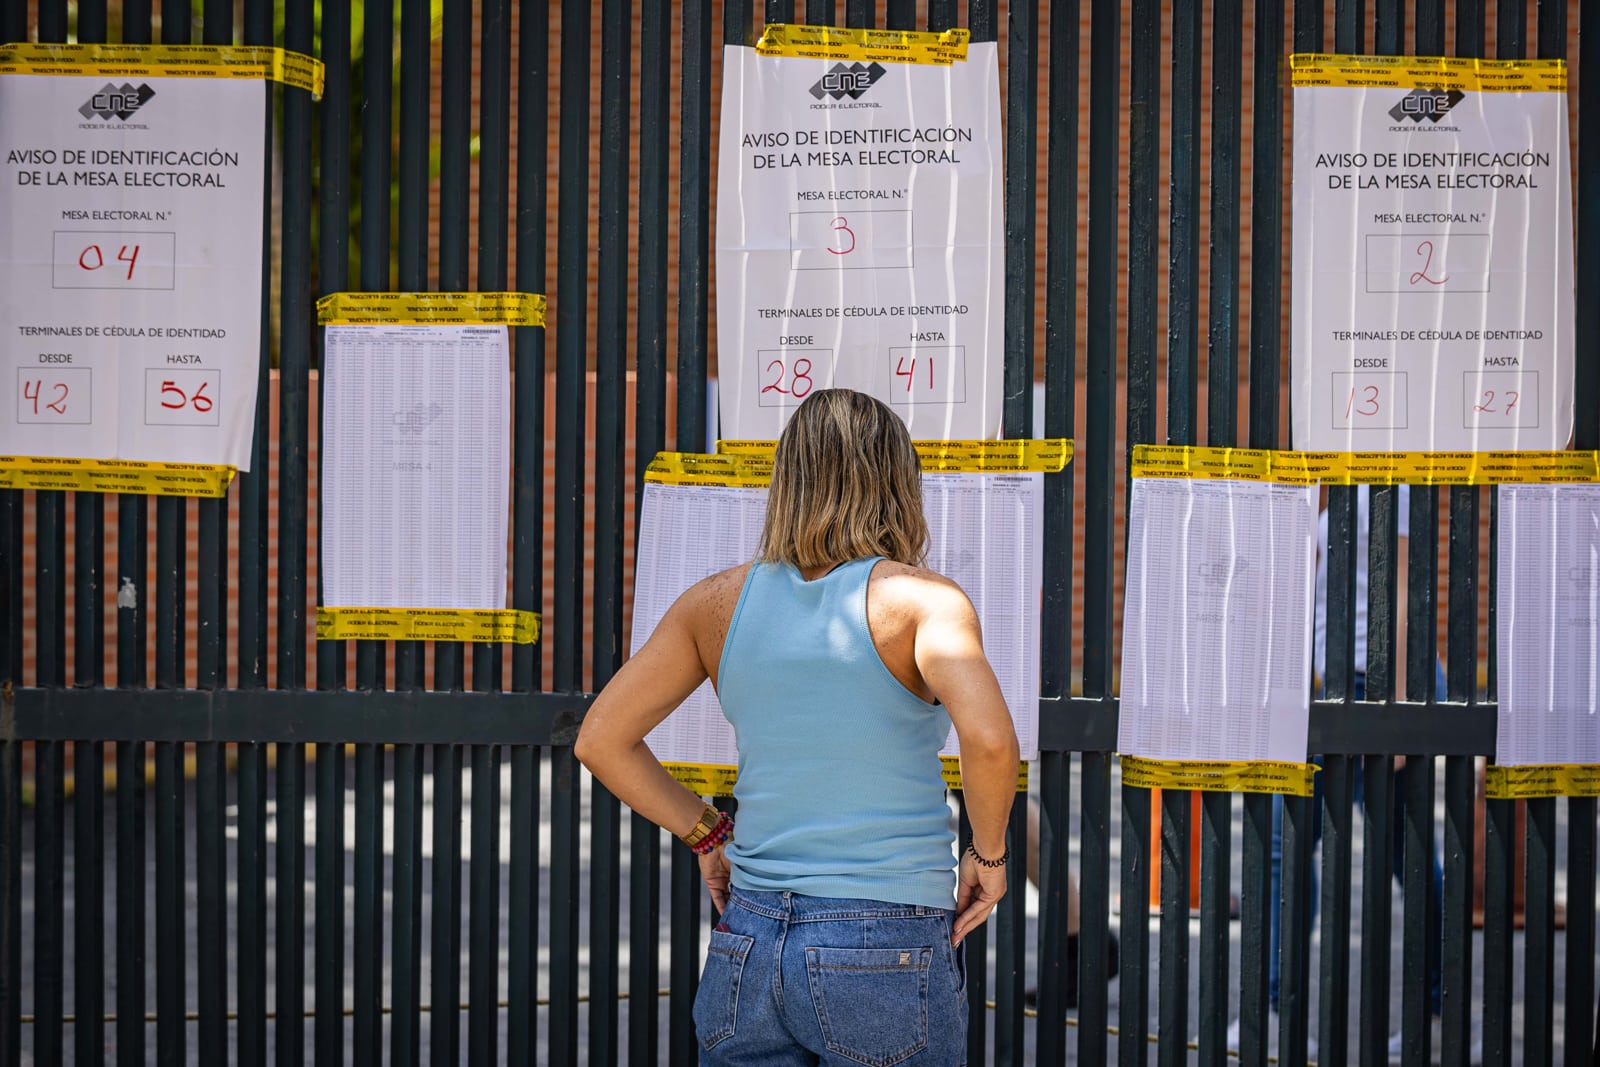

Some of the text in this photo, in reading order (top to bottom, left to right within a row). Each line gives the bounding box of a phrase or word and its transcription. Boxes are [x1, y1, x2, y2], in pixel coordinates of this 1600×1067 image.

[822, 72, 872, 91] CNE
[91, 92, 139, 111] CNE
[1401, 94, 1450, 113] CNE
[742, 124, 972, 148] AVISO DE IDENTIFICACIÓN
[8, 148, 238, 166] AVISO DE IDENTIFICACIÓN
[754, 150, 960, 169] DE LA MESA ELECTORAL
[1315, 149, 1549, 168] AVISO DE IDENTIFICACIÓN
[18, 171, 225, 188] DE LA MESA ELECTORAL
[1329, 174, 1538, 189] DE LA MESA ELECTORAL
[797, 191, 825, 200] MESA
[828, 190, 889, 200] ELECTORAL
[62, 210, 90, 220] MESA
[92, 210, 153, 221] ELECTORAL
[1374, 214, 1402, 223] MESA
[1405, 213, 1467, 223] ELECTORAL
[825, 214, 856, 256] 3
[1409, 240, 1449, 288] 2
[758, 305, 968, 318] TERMINALES DE CÉDULA DE IDENTIDAD
[18, 326, 226, 338] TERMINALES DE CÉDULA DE IDENTIDAD
[780, 336, 814, 345] DESDE
[910, 332, 945, 342] HASTA
[1332, 329, 1543, 341] TERMINALES DE CÉDULA DE IDENTIDAD
[39, 353, 72, 364] DESDE
[167, 354, 202, 364] HASTA
[1354, 358, 1388, 368] DESDE
[1484, 357, 1519, 366] HASTA
[760, 358, 814, 398] 28
[896, 357, 934, 392] 41
[23, 379, 70, 416] 42
[160, 380, 212, 412] 56
[1344, 384, 1380, 419] 13
[1472, 390, 1519, 416] 27
